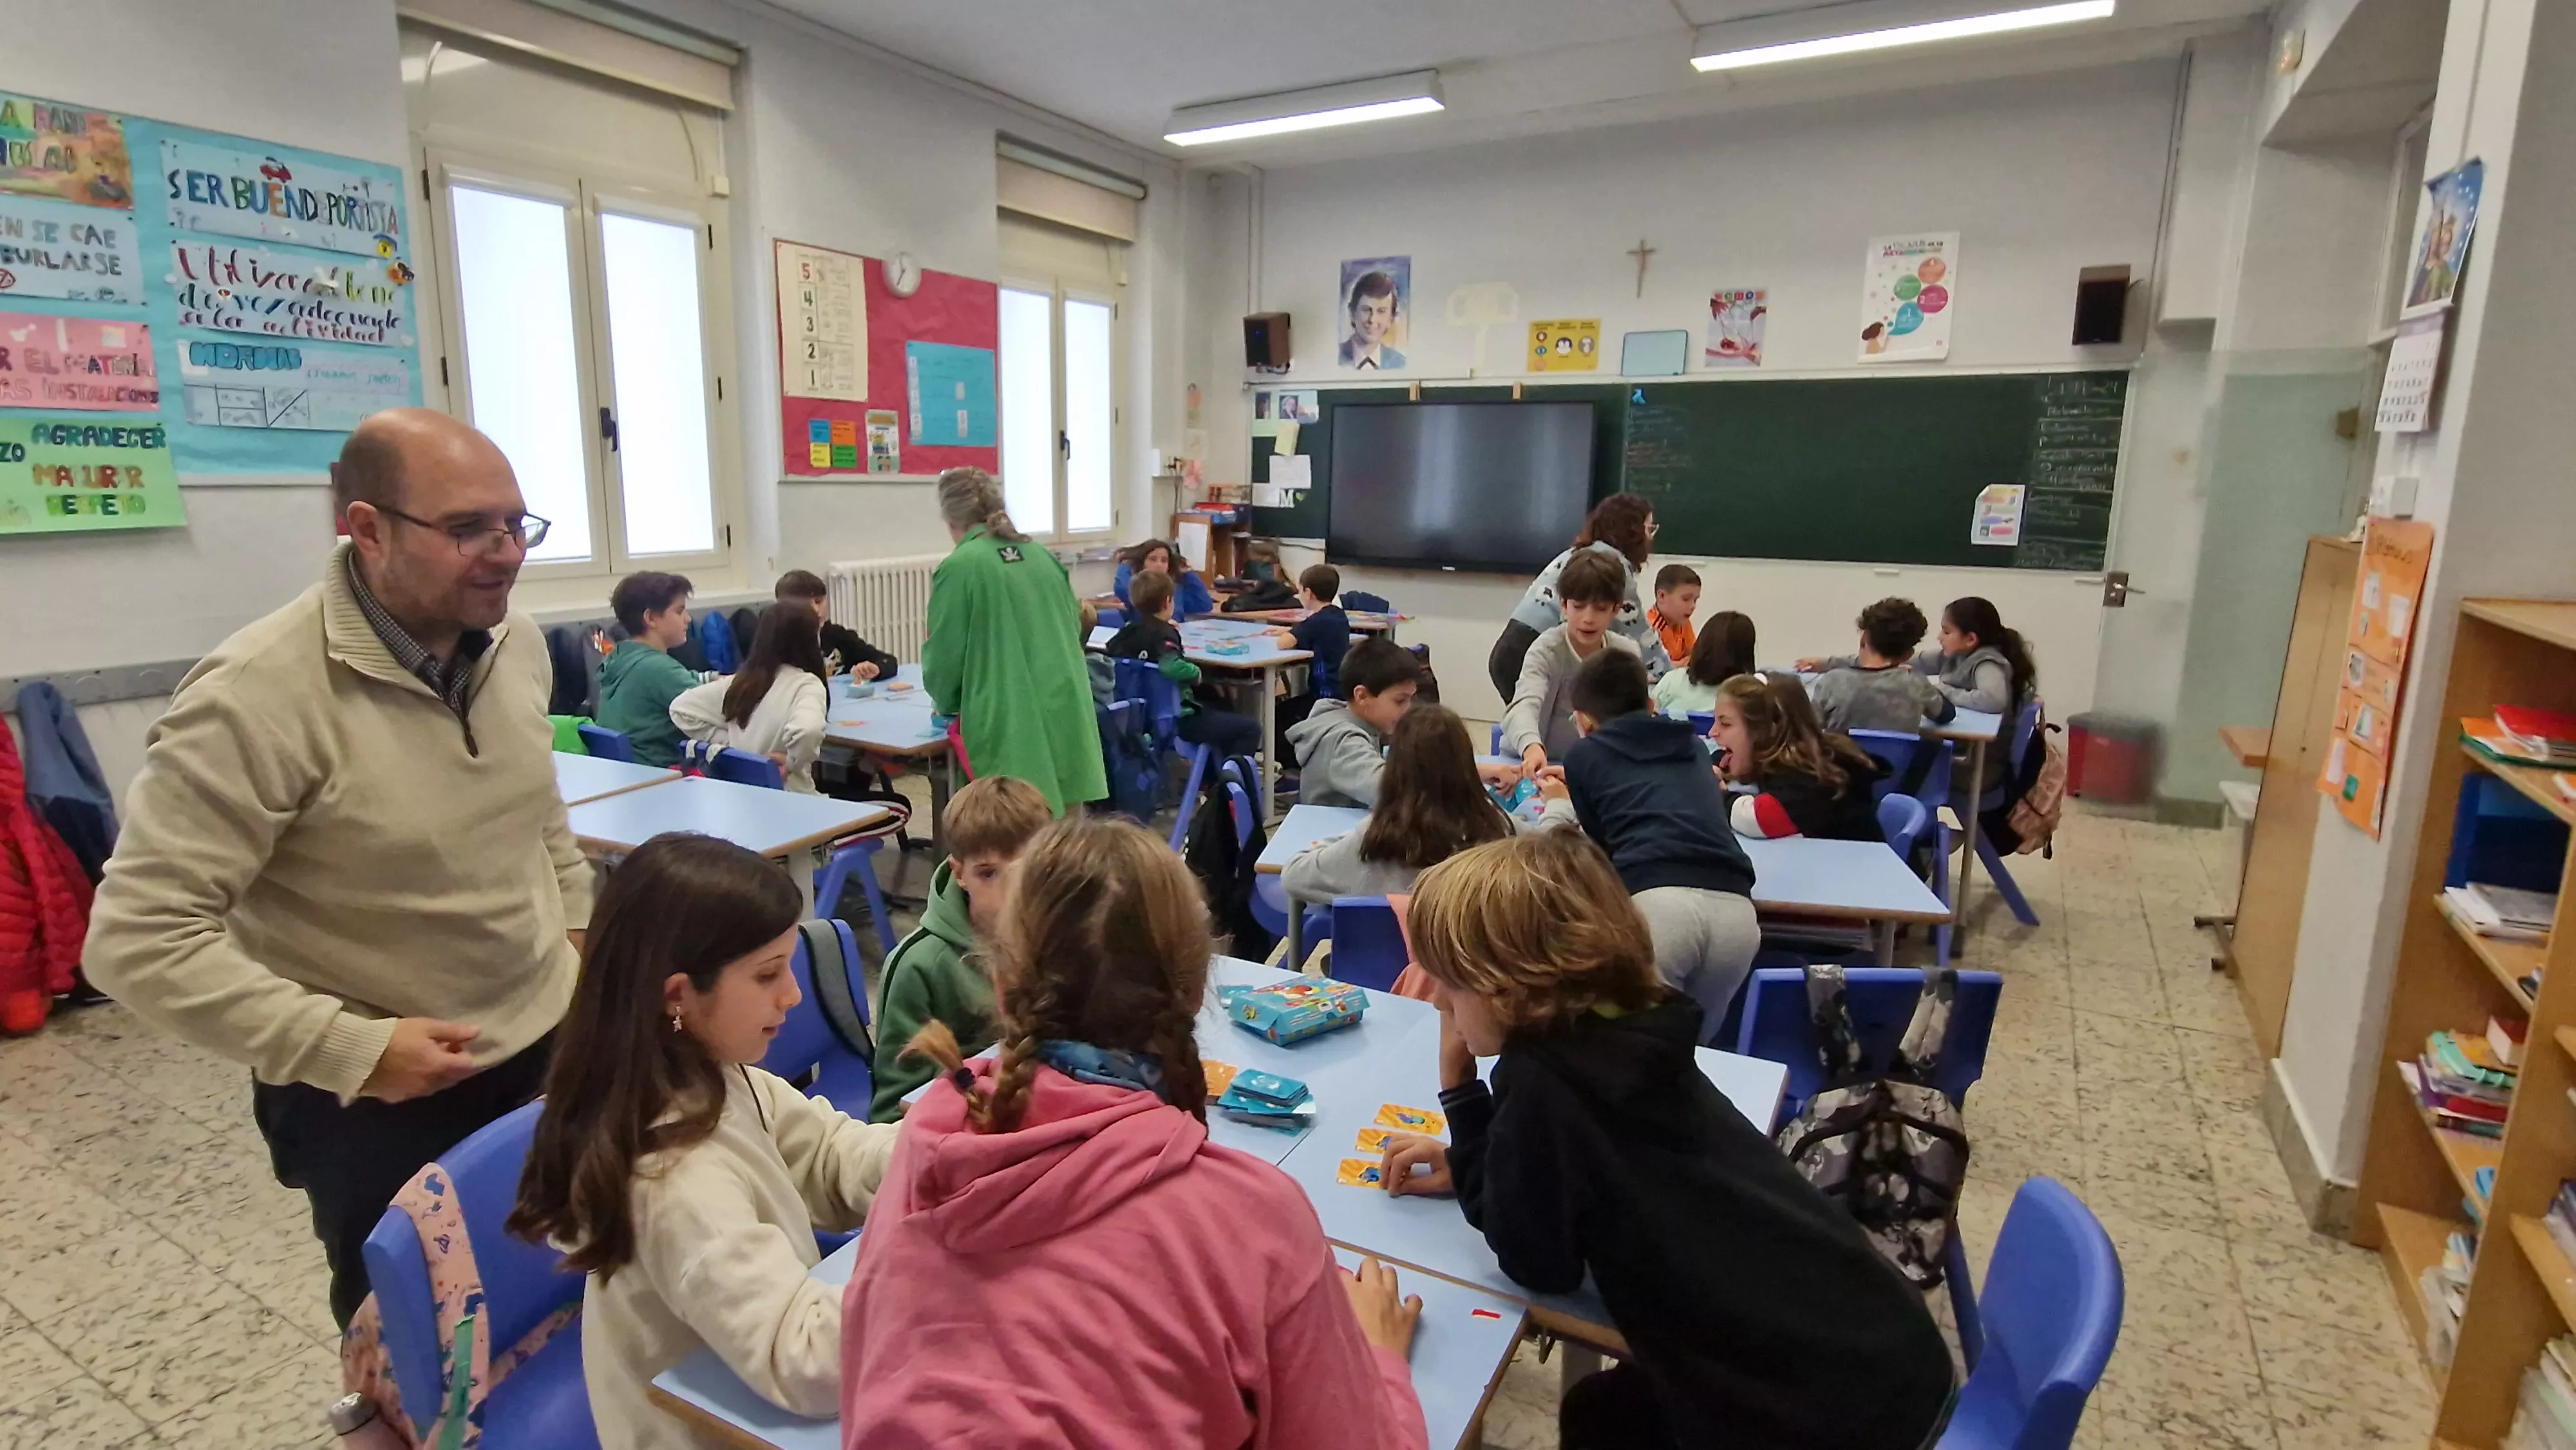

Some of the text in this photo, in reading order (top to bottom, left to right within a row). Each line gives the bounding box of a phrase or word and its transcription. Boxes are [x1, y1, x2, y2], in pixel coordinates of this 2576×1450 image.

[167, 169, 399, 235] SER BUEN DEPORTISTA
[32, 220, 59, 243] SE
[70, 223, 117, 249] CAE
[0, 243, 122, 276] BURLARSE
[801, 262, 811, 280] 5
[803, 290, 813, 308] 4
[806, 315, 814, 332] 3
[24, 347, 61, 375] EL
[189, 341, 303, 371] NORMAS
[808, 343, 816, 360] 2
[32, 422, 167, 449] AGRADECER
